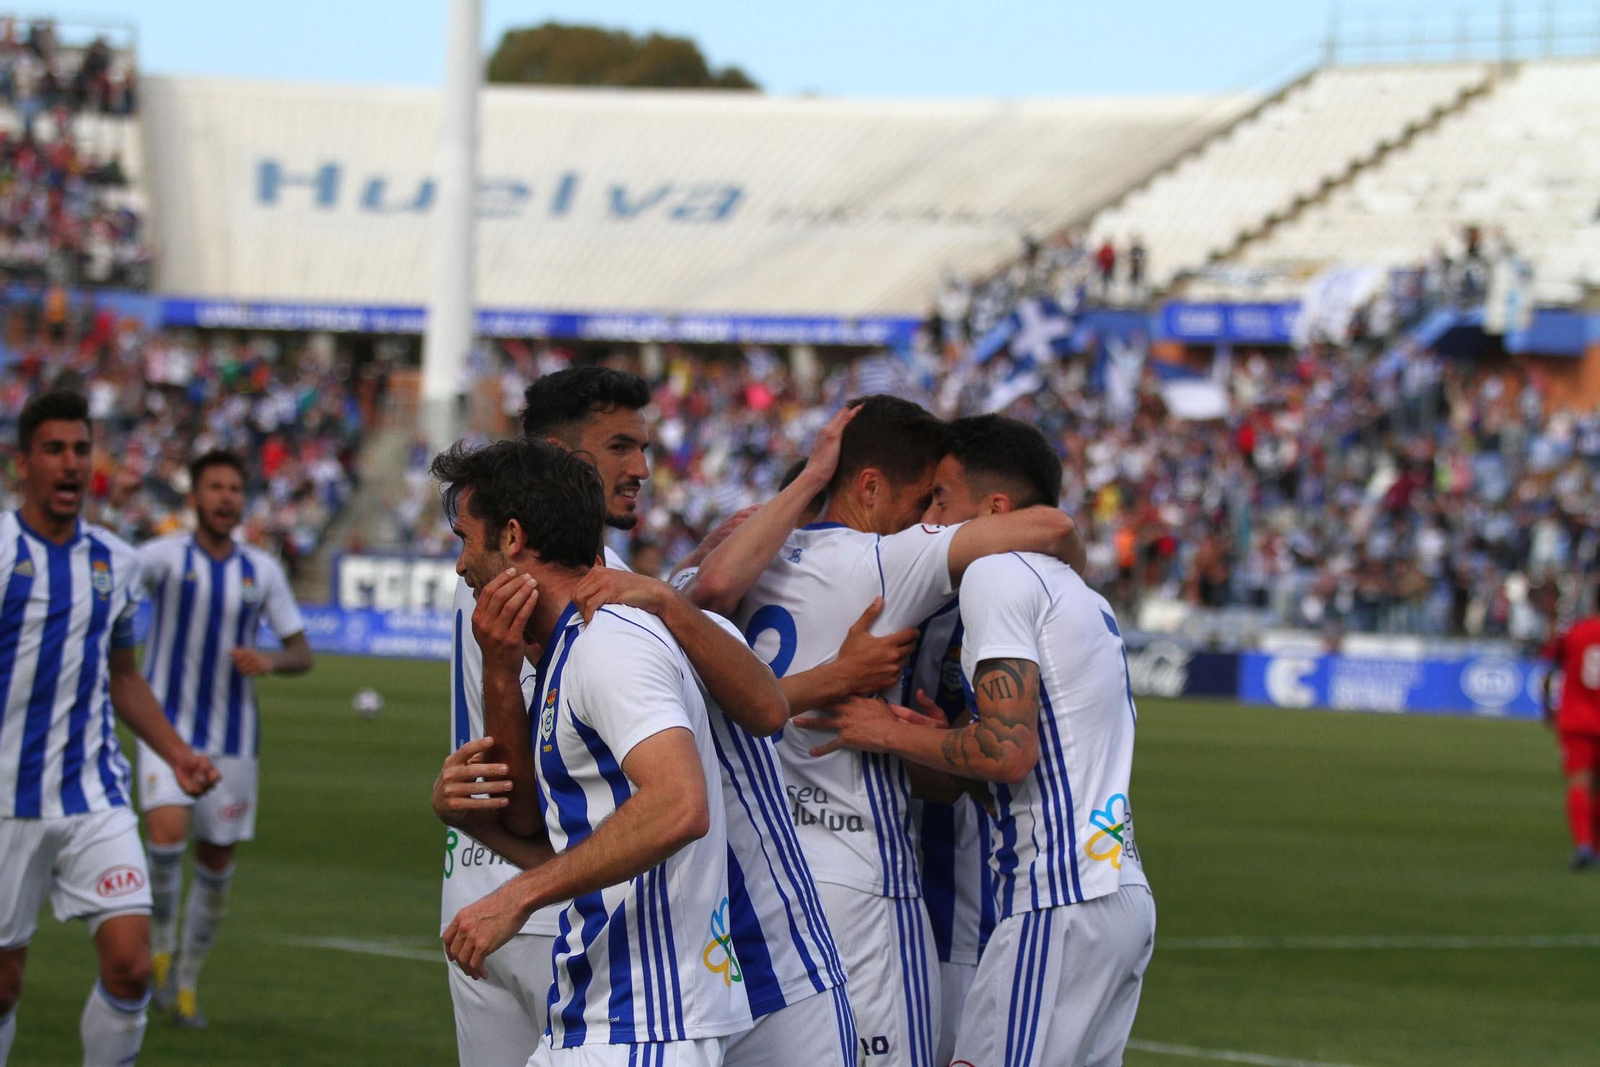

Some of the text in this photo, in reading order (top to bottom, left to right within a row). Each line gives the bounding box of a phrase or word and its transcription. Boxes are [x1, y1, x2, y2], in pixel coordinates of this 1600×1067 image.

[256, 158, 747, 223] Huelva
[980, 676, 1013, 702] VII
[792, 803, 865, 833] ulva
[461, 841, 485, 867] de
[103, 871, 140, 896] KIA
